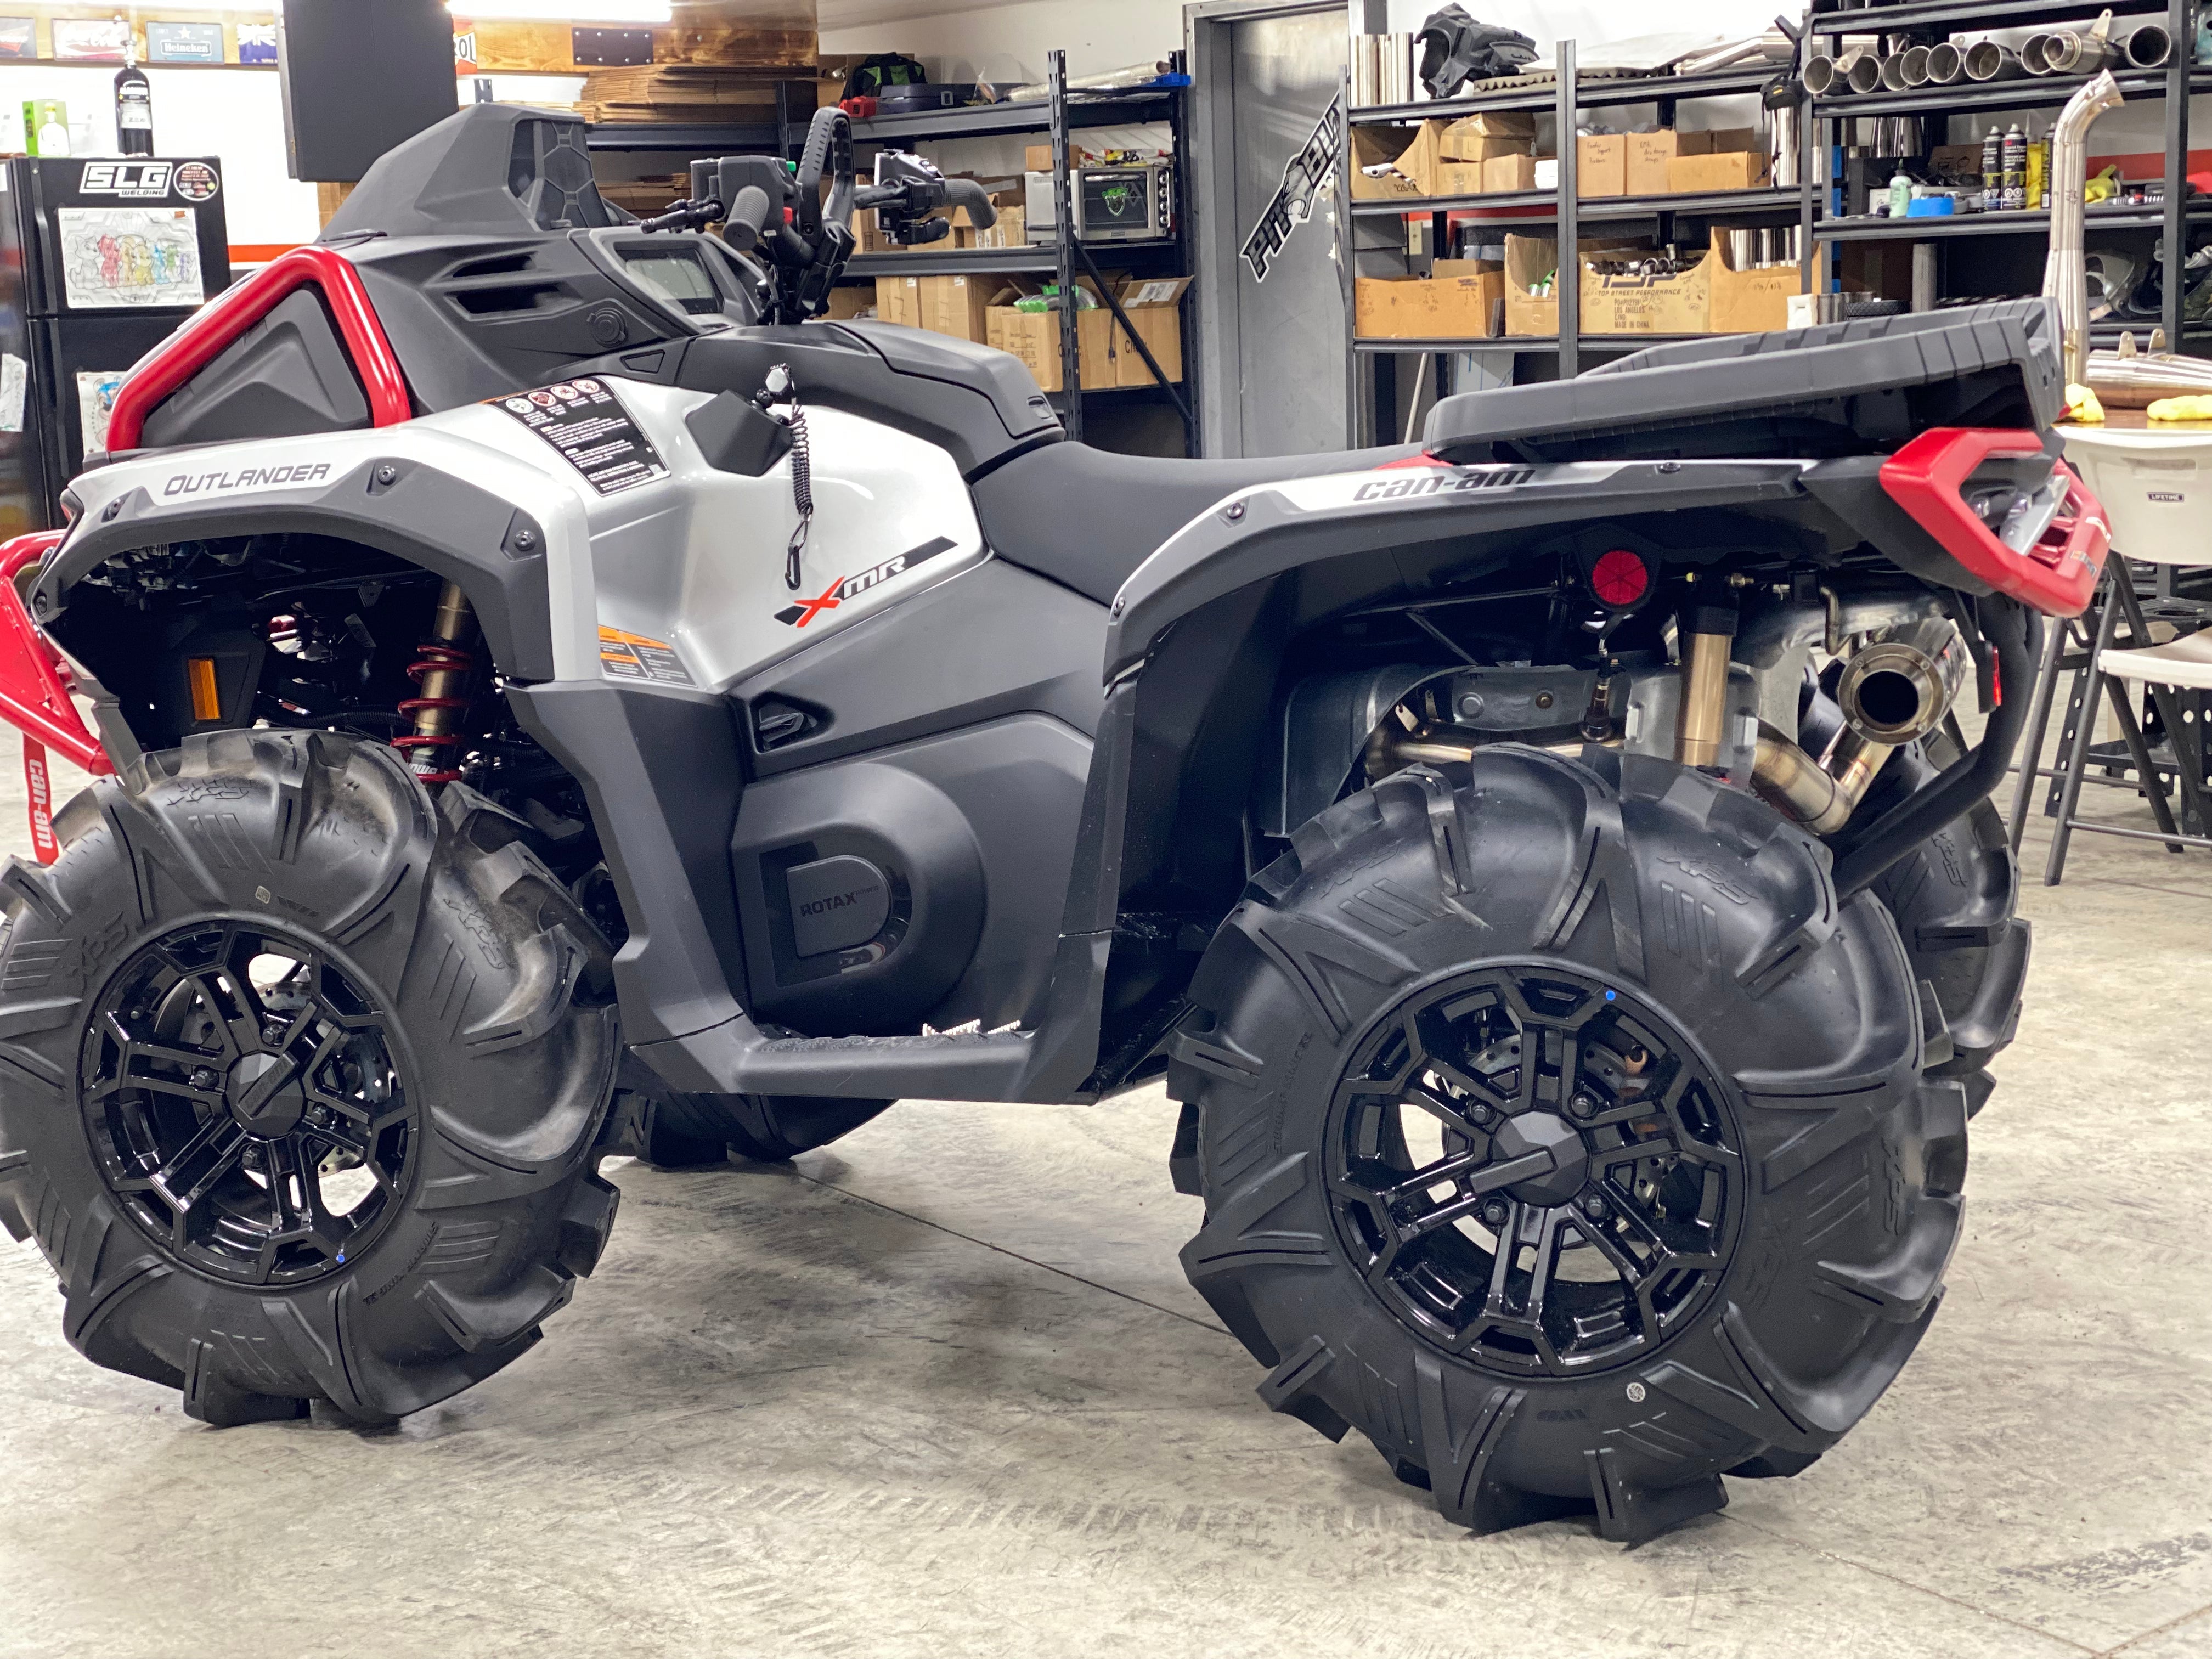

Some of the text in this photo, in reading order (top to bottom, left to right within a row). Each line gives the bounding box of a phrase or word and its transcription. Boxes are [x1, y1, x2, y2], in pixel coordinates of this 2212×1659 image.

[165, 42, 208, 53] Heineken
[86, 167, 167, 188] SLG
[163, 463, 331, 496] OUTLANDER
[1353, 470, 1536, 501] can-am
[29, 759, 53, 849] can-am
[800, 893, 857, 918] ROTAX
